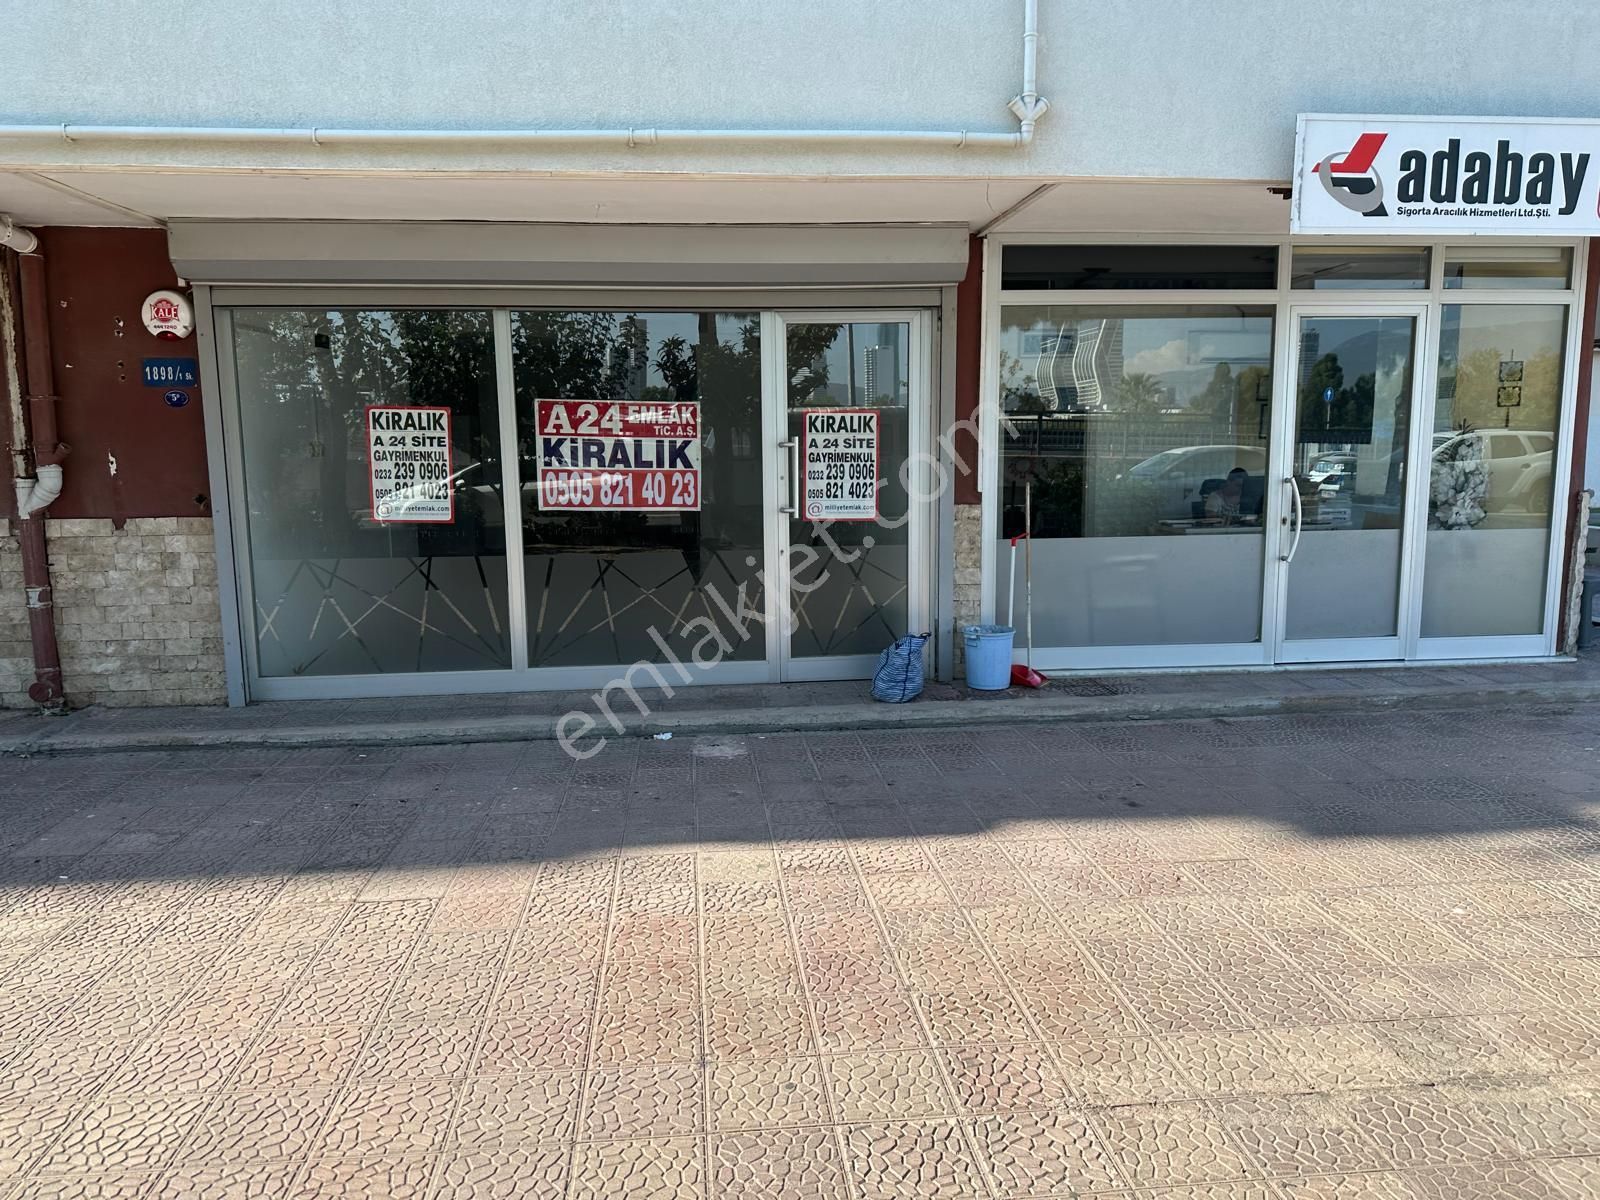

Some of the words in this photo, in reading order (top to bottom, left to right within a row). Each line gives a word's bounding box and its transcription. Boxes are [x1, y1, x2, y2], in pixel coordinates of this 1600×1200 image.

[1397, 138, 1591, 216] adabay
[1397, 206, 1431, 217] Sigorta
[1432, 207, 1468, 217] Aracılık
[1469, 208, 1517, 218] Hizmetleri
[151, 305, 179, 320] KALE
[628, 405, 696, 425] EMLAK
[676, 426, 696, 438] A.Ş.
[373, 436, 385, 447] A
[389, 436, 406, 447] 24
[411, 433, 447, 448] SİTE
[808, 438, 819, 449] A
[822, 438, 839, 449] 24
[843, 435, 875, 449] SİTE
[373, 447, 448, 463] GAYRİMENKUL
[808, 449, 875, 463] GAYRİMENKUL
[374, 469, 392, 480] 0232
[394, 462, 415, 480] 239
[419, 463, 448, 480] 0906
[808, 470, 824, 481] 0232
[826, 463, 845, 481] 239
[848, 463, 875, 481] 0906
[375, 488, 393, 499] 0505
[420, 482, 449, 500] 4023
[545, 471, 594, 506] 0505
[600, 471, 633, 506] 821
[641, 472, 666, 506] 40
[671, 472, 695, 506] 23
[807, 489, 824, 499] 0505
[825, 482, 844, 499] 821
[848, 482, 875, 499] 4023
[824, 504, 875, 512] milliyetemlak.com
